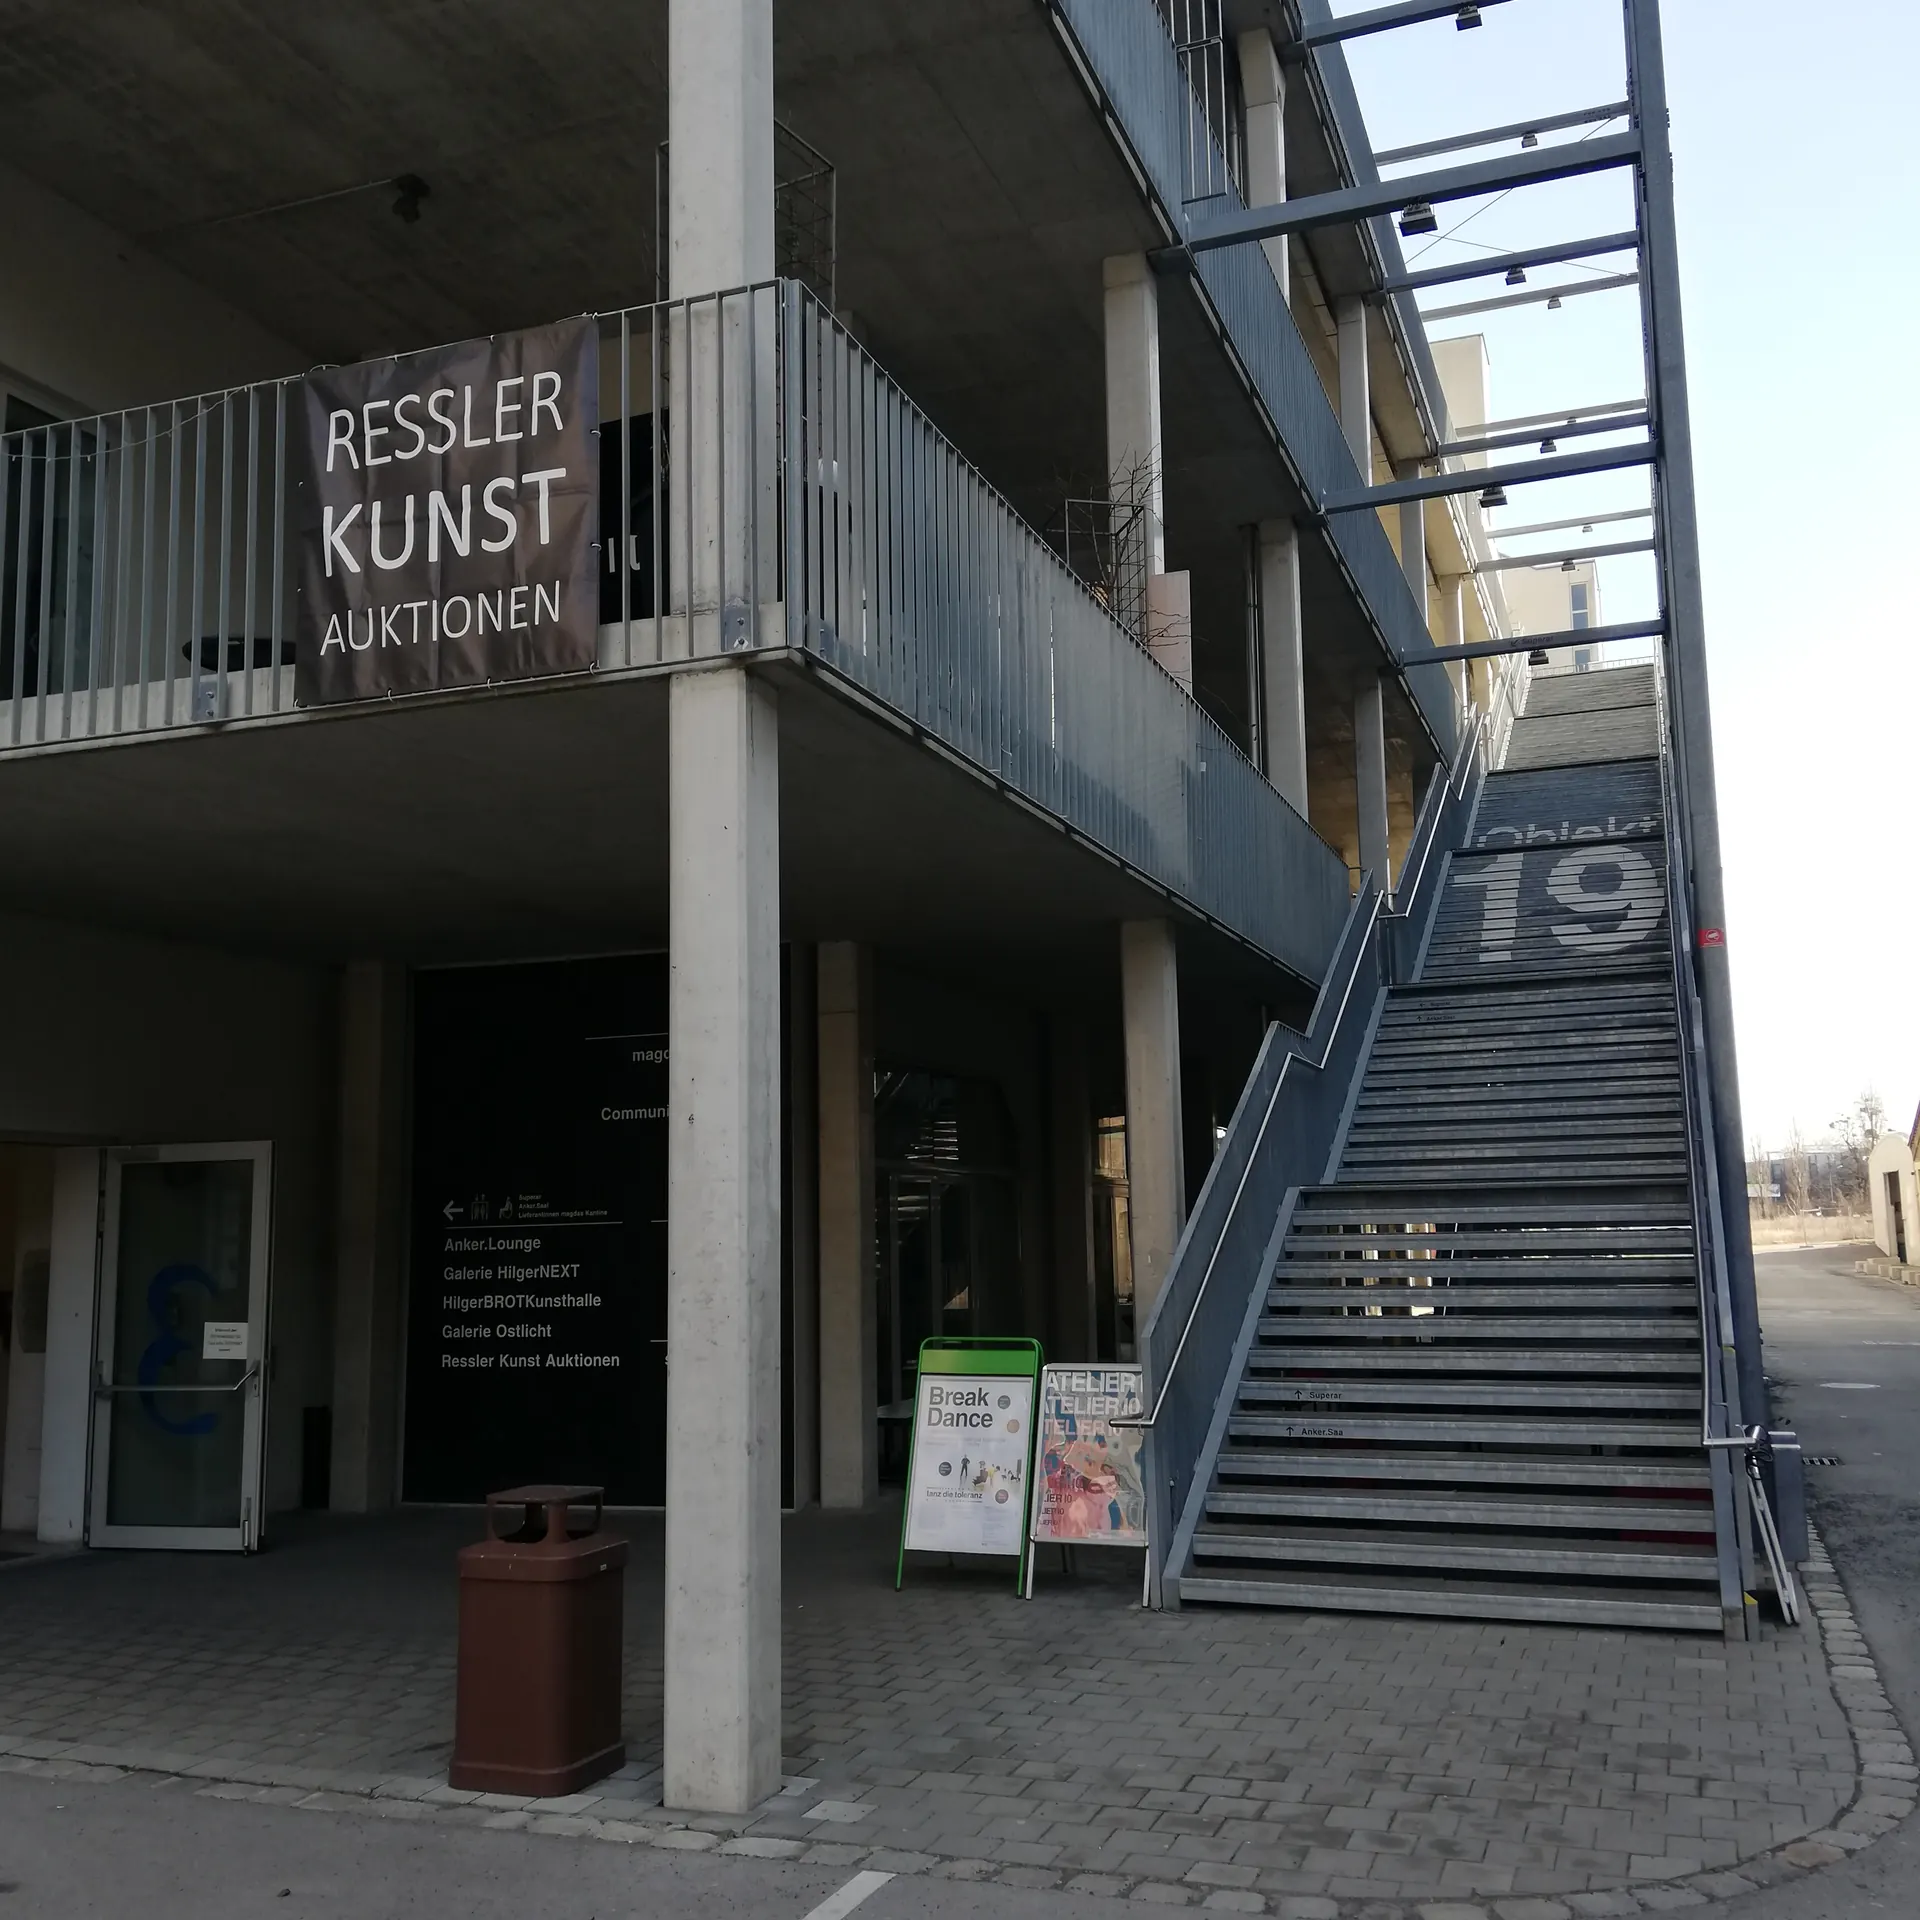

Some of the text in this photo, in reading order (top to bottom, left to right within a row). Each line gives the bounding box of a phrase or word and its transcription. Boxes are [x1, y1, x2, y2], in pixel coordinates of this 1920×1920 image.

[326, 371, 563, 472] RESSLER
[323, 468, 567, 577] KUNST
[320, 580, 560, 656] AUKTIONEN
[1450, 845, 1665, 962] 19
[444, 1237, 541, 1252] Anker.Lounge
[444, 1264, 580, 1282] Galerie HilgerNEXT
[443, 1293, 602, 1312] HilgerBROTKunsthalle
[442, 1324, 552, 1338] Galerie Ostlicht
[441, 1353, 620, 1367] Ressler Kunst Auktionen
[1047, 1371, 1136, 1393] ATELIER
[929, 1386, 990, 1407] Break
[1309, 1391, 1342, 1400] Superar
[927, 1407, 993, 1428] Dance
